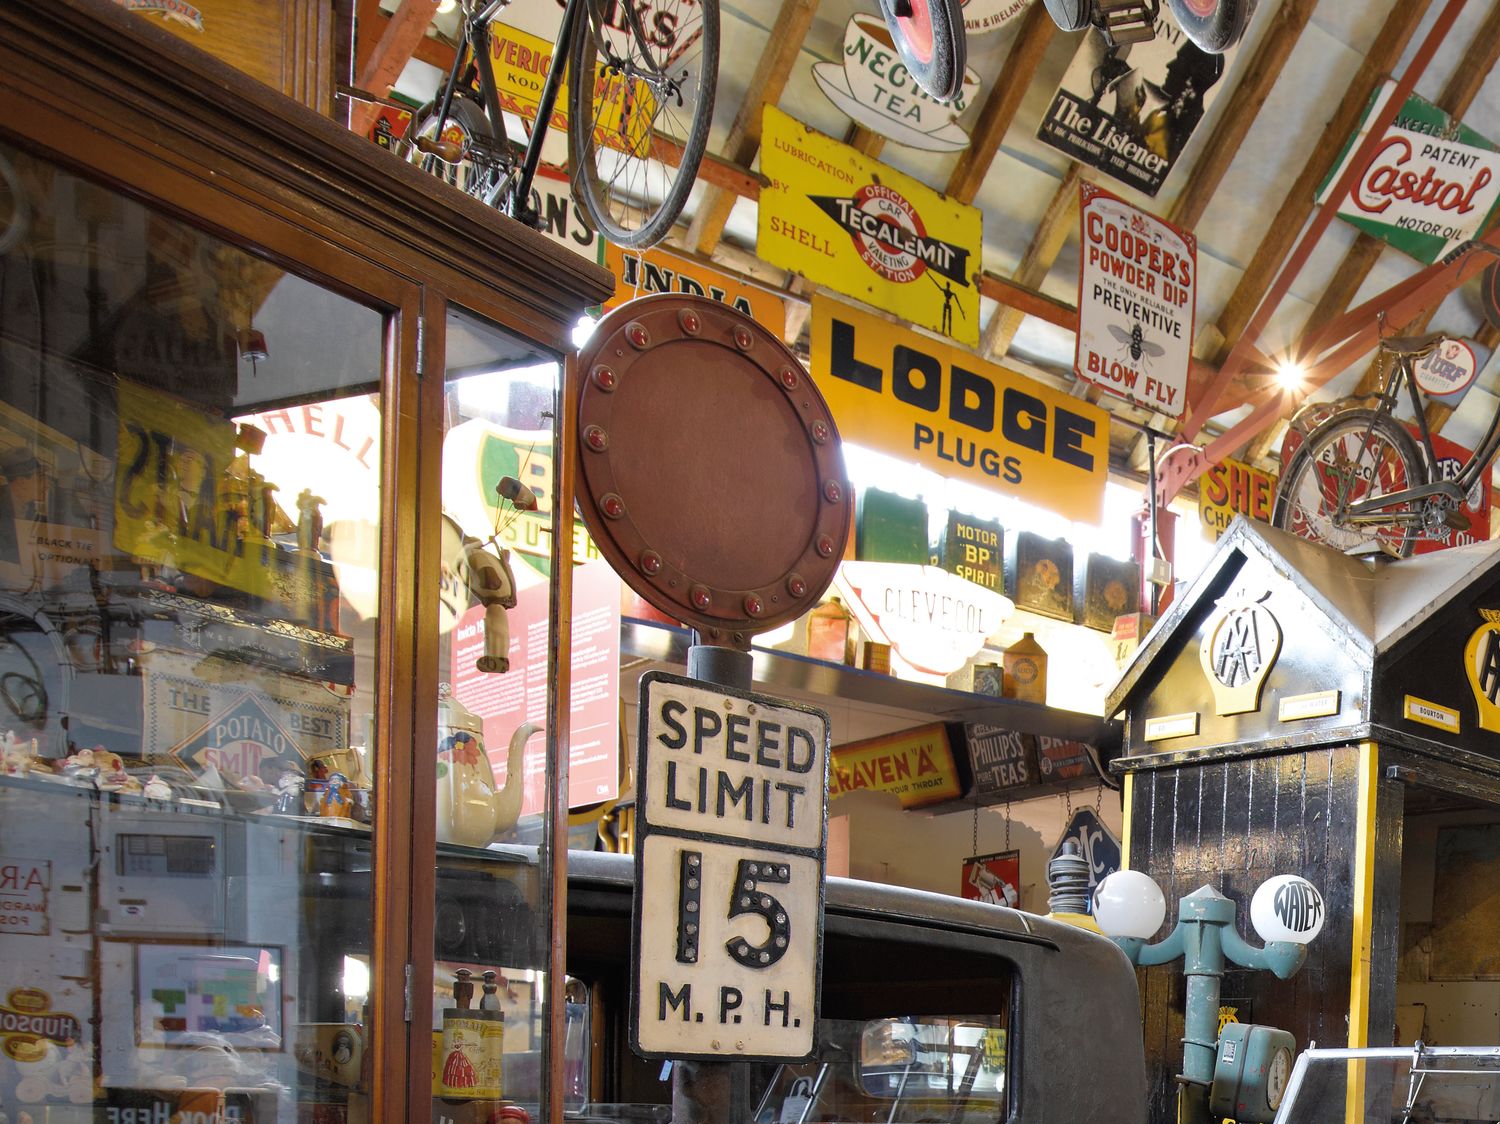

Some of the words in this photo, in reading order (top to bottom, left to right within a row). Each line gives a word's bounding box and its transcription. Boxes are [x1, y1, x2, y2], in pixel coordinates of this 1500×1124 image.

[873, 83, 921, 124] TEA
[1053, 95, 1092, 136] The
[1093, 116, 1170, 175] Listener
[1420, 143, 1480, 170] PATENT
[774, 137, 855, 185] LUBRICATION
[1350, 135, 1493, 214] Castrol
[772, 180, 790, 194] BY
[864, 185, 916, 219] OFFICIAL
[878, 199, 903, 217] CAR
[769, 216, 836, 258] SHELL
[835, 198, 956, 270] TECALEMIT
[1087, 211, 1191, 288] COOPER'S
[1396, 215, 1441, 236] MOTOR
[1446, 226, 1464, 241] OIL
[862, 251, 916, 283] STATION
[867, 241, 910, 267] VALETING
[1089, 244, 1157, 296] POWDER
[1163, 280, 1189, 308] DIP
[620, 252, 757, 318] INDIA
[1103, 277, 1118, 291] THE
[1120, 284, 1137, 299] ONLY
[1140, 294, 1174, 317] RELIABLE
[1093, 283, 1182, 339] PREVENTIVE
[829, 317, 1098, 475] LODGE
[1087, 350, 1139, 390] BLOW
[1145, 375, 1178, 406] FLY
[912, 422, 1024, 486] PLUGS
[955, 522, 998, 547] MOTOR
[955, 565, 997, 589] SPIRIT
[168, 688, 212, 713] THE
[290, 712, 333, 735] BEST
[1418, 706, 1445, 721] BOURTON
[215, 715, 287, 754] POTATO
[658, 699, 816, 775] SPEED
[665, 760, 806, 830] LIMIT
[828, 750, 912, 795] CRAVEN
[912, 777, 945, 791] THROAT
[993, 760, 1028, 788] TEAS
[674, 849, 792, 970] 15
[1274, 878, 1323, 935] WATER
